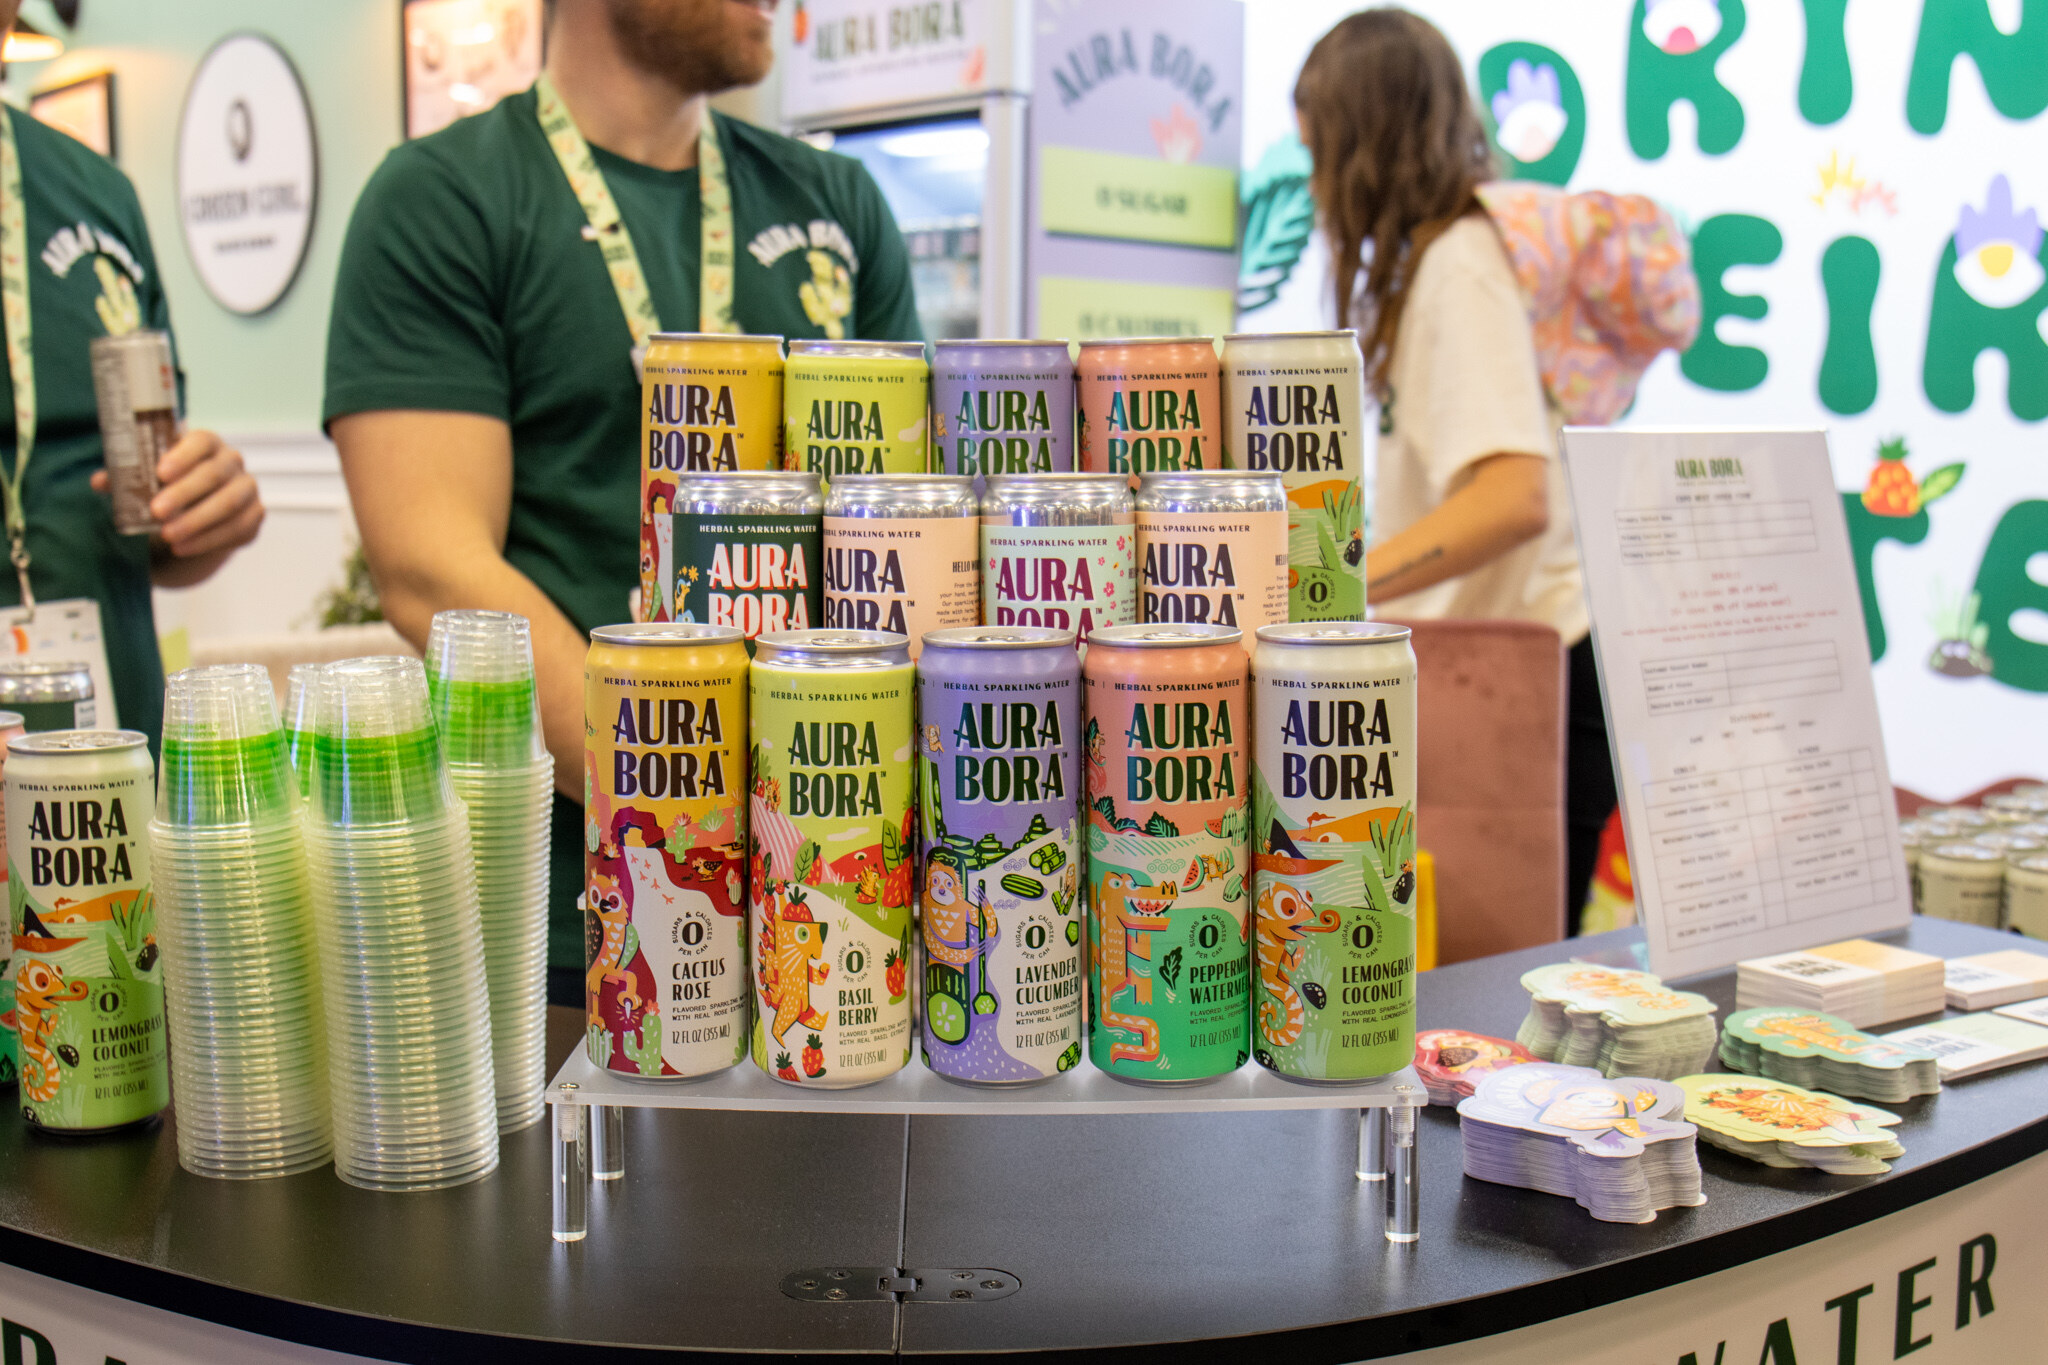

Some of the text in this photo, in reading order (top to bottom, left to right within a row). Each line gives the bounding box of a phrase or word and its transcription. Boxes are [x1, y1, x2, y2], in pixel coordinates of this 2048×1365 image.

[1052, 29, 1231, 133] AURA BORA
[667, 368, 714, 376] SPARKLING
[823, 374, 873, 383] SPARKLING
[877, 376, 904, 384] WATER
[1034, 373, 1059, 381] WATER
[1131, 373, 1182, 381] SPARKLING
[1270, 368, 1321, 376] SPARKLING
[1324, 367, 1348, 375] WATER
[649, 384, 737, 427] AURA
[955, 391, 1052, 434] AURA
[1105, 389, 1202, 433] AURA
[1245, 384, 1341, 426] AURA
[807, 400, 885, 441] AURA
[1675, 458, 1743, 479] AURA BORA
[700, 525, 734, 533] HERBAL
[738, 525, 791, 533] SPARKLING
[838, 530, 884, 538] SPARKLING
[990, 538, 1017, 546] HERBAL
[707, 543, 808, 590] AURA
[825, 548, 906, 594] AURA
[952, 561, 971, 573] HELLO
[1143, 543, 1236, 588] AURA
[996, 557, 1095, 602] AURA
[1309, 581, 1328, 603] 0
[604, 677, 732, 688] HERBAL SPARKLING WATER
[943, 680, 1070, 692] HERBAL SPARKLING WATER
[1114, 679, 1240, 692] HERBAL SPARKLING WATER
[1272, 678, 1401, 689] HERBAL SPARKLING WATER
[770, 690, 899, 702] HERBAL SPARKLING WATER
[612, 697, 724, 746] AURA
[953, 700, 1063, 751] AURA
[1124, 700, 1234, 751] AURA
[1281, 698, 1391, 747] AURA
[787, 721, 880, 768] AURA
[19, 779, 135, 792] HERBAL SPARKLING WATER
[28, 797, 128, 842] AURA
[672, 911, 713, 944] SUGARS CALORIES
[682, 921, 705, 946] 0
[1025, 925, 1046, 949] 0
[1198, 924, 1219, 949] 0
[1352, 925, 1374, 949] 0
[678, 944, 709, 956] PER CAN
[672, 958, 726, 980] CACTUS
[845, 950, 864, 974] 0
[1016, 956, 1077, 985] LAVENDER
[672, 981, 711, 1001] ROSE
[838, 988, 873, 1007] BASIL
[1016, 976, 1079, 1005] CUCUMBER
[1342, 980, 1403, 1005] COCONUT
[100, 992, 119, 1013] 0
[672, 1005, 707, 1013] FLAVORED
[1016, 1008, 1050, 1018] FLAVORED
[838, 1006, 879, 1026] BERRY
[1016, 1018, 1034, 1026] WITH
[1037, 1016, 1052, 1024] REAL
[92, 1013, 163, 1044] LEMONGRASS
[672, 1031, 680, 1044] 12
[682, 1030, 690, 1043] FL
[692, 1029, 702, 1043] OZ
[839, 1029, 868, 1038] FLAVORED
[874, 1034, 888, 1042] BASIL
[93, 1038, 150, 1062] COCONUT
[1016, 1035, 1024, 1049] 12
[1025, 1034, 1034, 1047] FL
[1035, 1033, 1045, 1046] OZ
[1342, 1034, 1350, 1048] 12
[1351, 1033, 1360, 1047] FL
[1361, 1032, 1371, 1046] OZ
[839, 1054, 846, 1068] 12
[847, 1053, 854, 1067] FL
[854, 1052, 863, 1066] OZ
